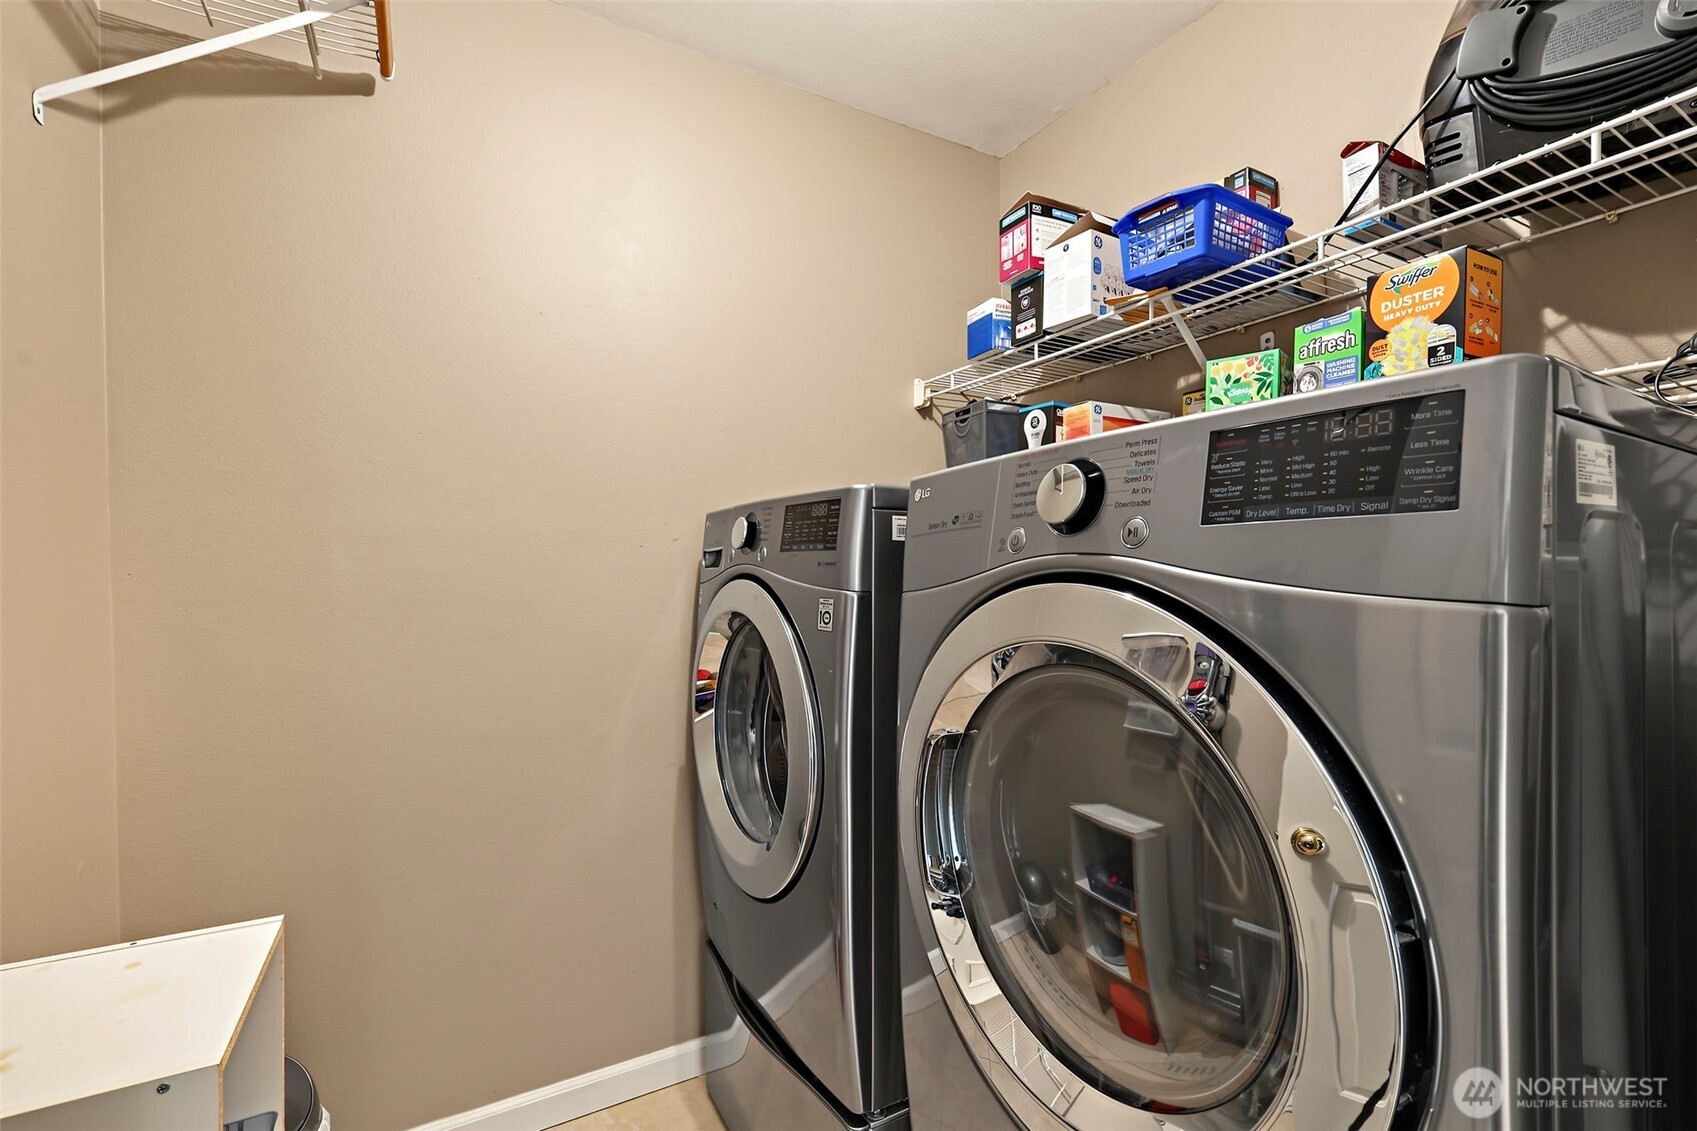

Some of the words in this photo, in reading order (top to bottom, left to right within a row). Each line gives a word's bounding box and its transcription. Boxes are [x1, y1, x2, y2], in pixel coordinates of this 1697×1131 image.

[1385, 264, 1438, 291] Swiffer
[1380, 285, 1445, 313] DUSTER
[1383, 309, 1413, 322] HEAVY
[1415, 300, 1441, 312] DUTY
[1299, 329, 1357, 360] affresh
[1371, 343, 1389, 352] DUST
[1436, 346, 1446, 356] 2
[1326, 357, 1356, 368] WASHING
[1429, 354, 1452, 364] SIDED
[1326, 363, 1356, 374] MACHINE
[1326, 368, 1356, 379] CLEANER
[1411, 412, 1431, 421] More
[1433, 409, 1453, 417] Time
[1125, 441, 1141, 449] Perm
[1142, 438, 1158, 446] Press
[1410, 441, 1429, 449] Less
[1431, 438, 1450, 446] Time
[1129, 449, 1157, 459] Delicates
[1134, 459, 1156, 468] Towels
[1211, 462, 1230, 470] Reduce
[1230, 460, 1246, 468] Static
[1404, 466, 1434, 475] Wrinkle
[1435, 465, 1454, 473] Care
[1123, 476, 1141, 484] Speed
[1142, 475, 1153, 483] Dry
[921, 487, 931, 499] LG
[1131, 487, 1141, 495] Air
[1141, 486, 1152, 495] Dry
[1210, 486, 1227, 494] Energy
[1114, 499, 1151, 509] Downloaded
[1399, 497, 1419, 505] Damp
[1420, 496, 1433, 504] Dry
[1433, 495, 1456, 504] Signal
[1285, 507, 1309, 516] Temp.
[1318, 504, 1336, 513] Time
[1336, 503, 1351, 513] Dry
[1361, 501, 1389, 512] Signal
[1246, 510, 1259, 519] Dry
[1259, 508, 1277, 517] Level
